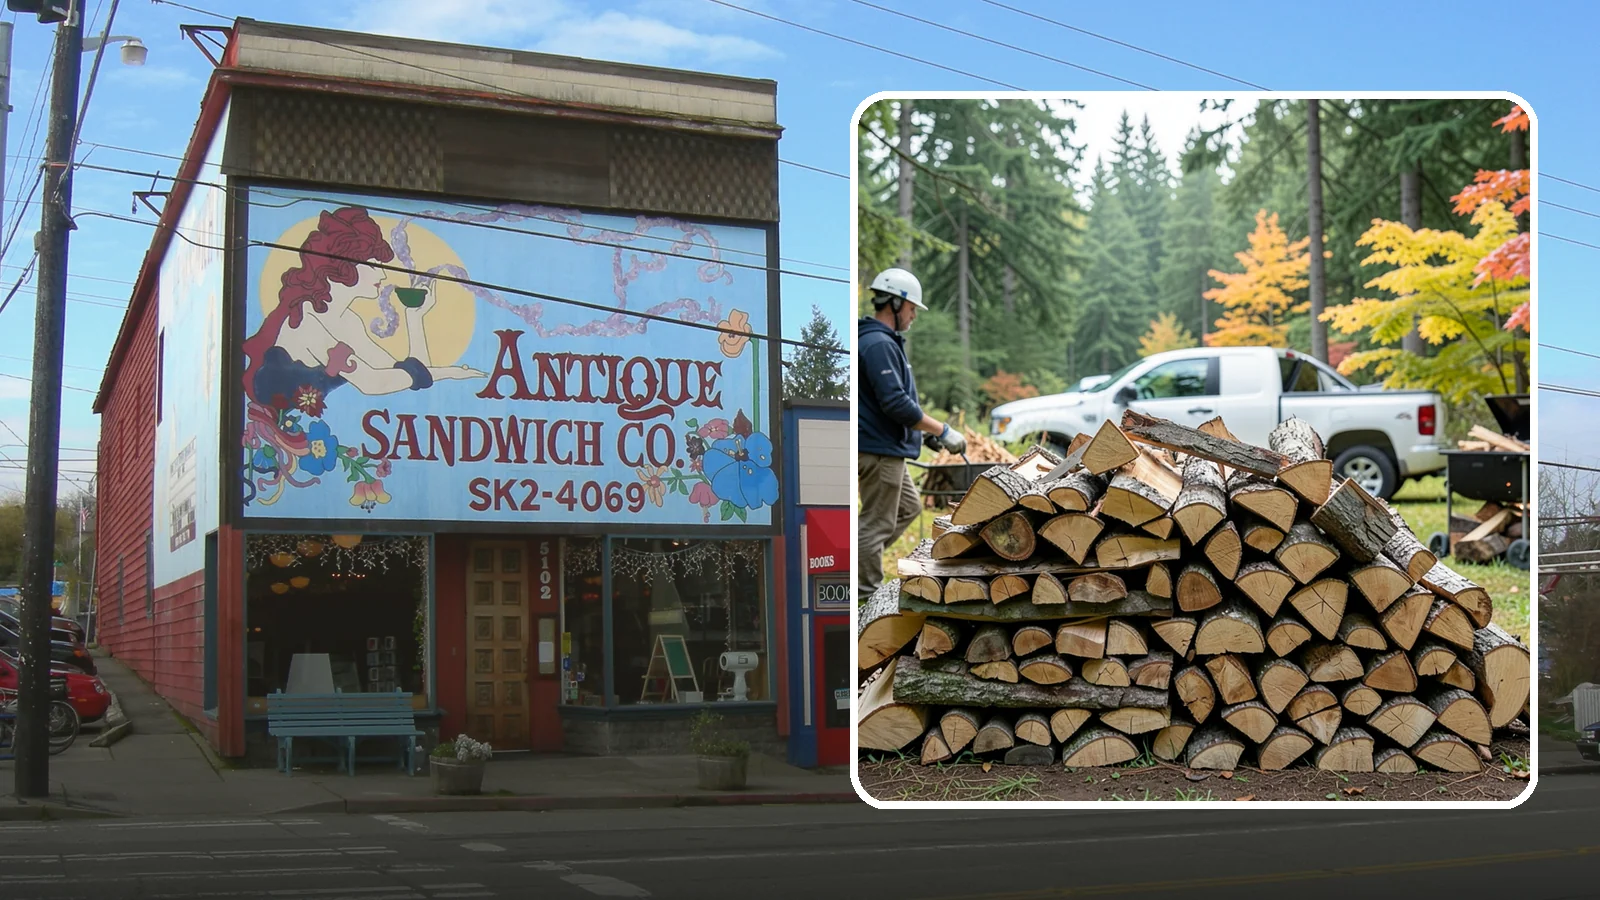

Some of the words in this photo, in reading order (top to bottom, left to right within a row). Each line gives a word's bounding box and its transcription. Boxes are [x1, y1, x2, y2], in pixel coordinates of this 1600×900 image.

[476, 329, 724, 420] ANTIQUE
[361, 408, 604, 467] SANDWICH
[617, 422, 685, 469] CO.
[468, 477, 646, 513] SK2-4069
[539, 541, 551, 599] 5102
[809, 555, 835, 569] BOOKS
